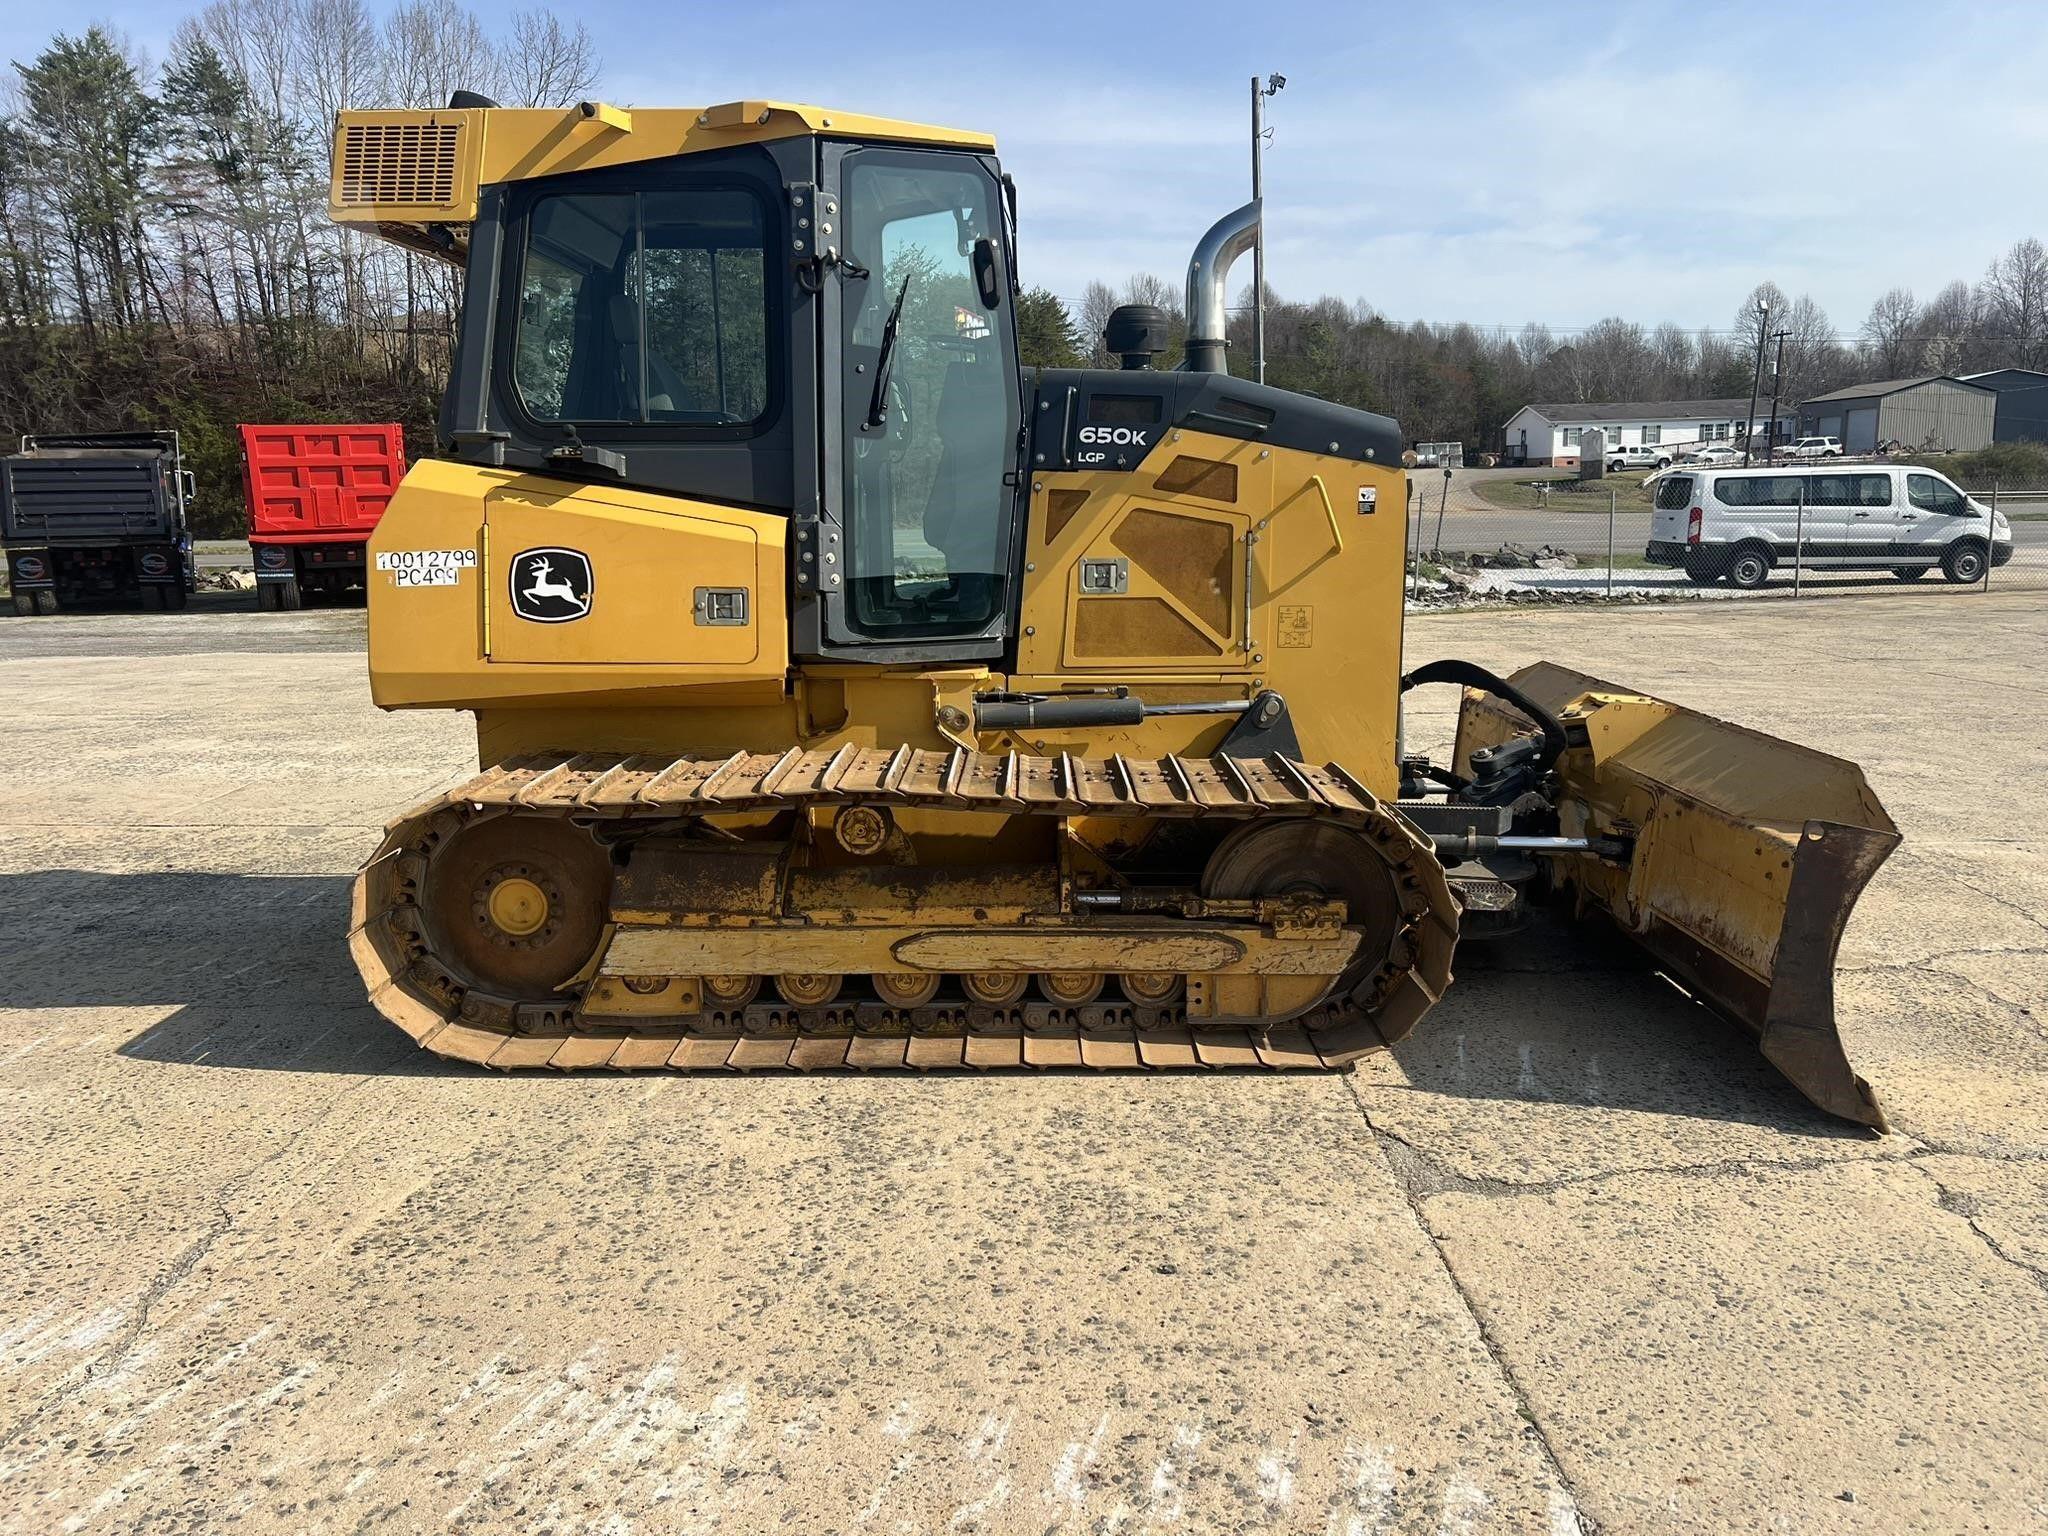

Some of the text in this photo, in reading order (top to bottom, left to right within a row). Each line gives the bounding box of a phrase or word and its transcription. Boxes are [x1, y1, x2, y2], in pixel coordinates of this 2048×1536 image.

[1079, 427, 1147, 446] 650K
[1078, 452, 1105, 463] LGP
[378, 549, 476, 569] 10012799
